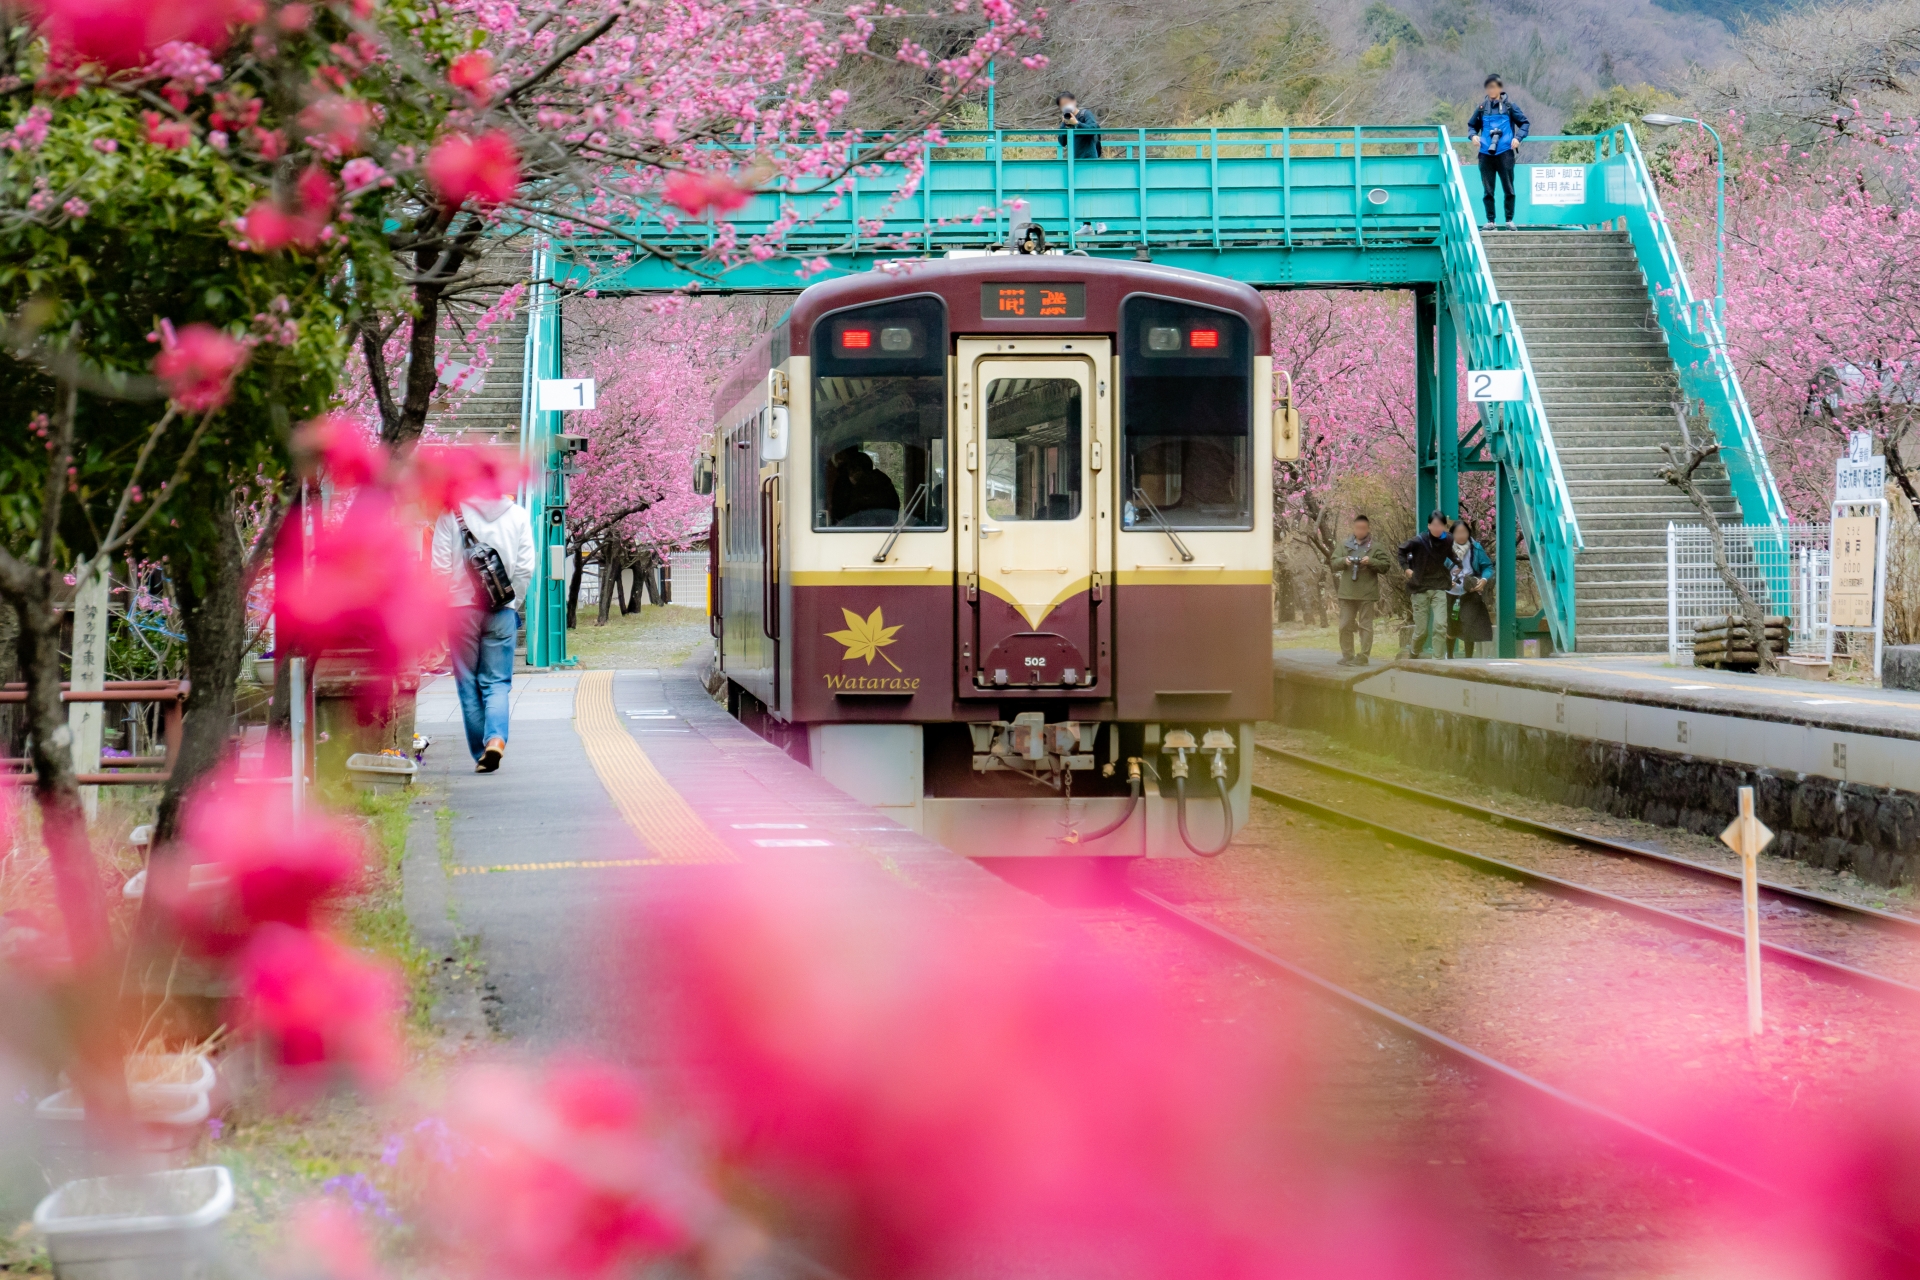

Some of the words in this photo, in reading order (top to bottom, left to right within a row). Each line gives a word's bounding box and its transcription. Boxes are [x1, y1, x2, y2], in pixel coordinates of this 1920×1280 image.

[1535, 168, 1583, 178] 三脚・脚立
[1535, 181, 1583, 191] 使用禁止
[1474, 374, 1492, 398] 2
[573, 382, 584, 407] 1
[1024, 657, 1046, 667] 502
[823, 674, 920, 690] Watarase
